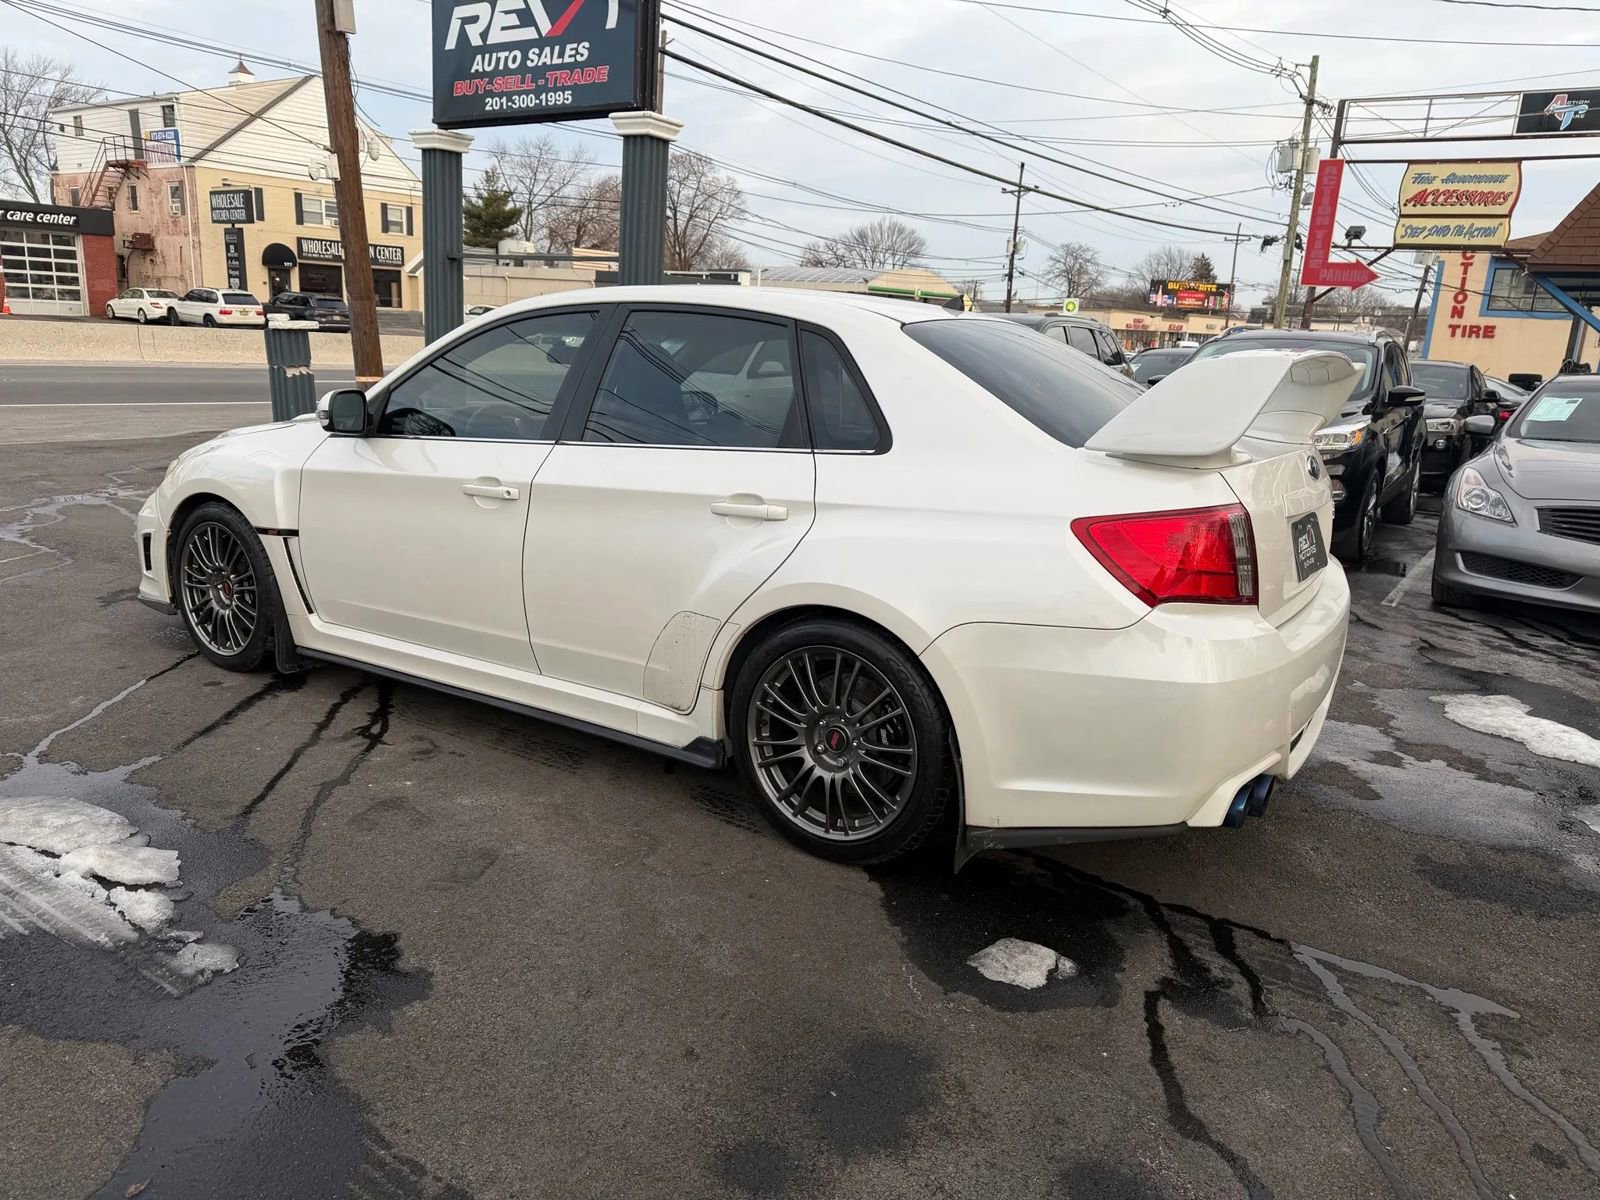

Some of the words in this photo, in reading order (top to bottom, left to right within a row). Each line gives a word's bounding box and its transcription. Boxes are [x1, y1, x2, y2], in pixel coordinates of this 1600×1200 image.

[470, 50, 521, 73] AUTO
[526, 41, 590, 67] SALES
[485, 91, 573, 111] 201-300-1995
[211, 193, 245, 208] WHOLESALE
[1403, 188, 1513, 207] ACCESSORIES
[6, 210, 34, 222] care
[36, 213, 77, 225] center
[212, 209, 230, 220] KITCHEN
[230, 209, 247, 220] CENTER
[301, 239, 342, 256] WHOLESALE
[376, 246, 402, 261] CENTER
[1451, 251, 1476, 319] CTION
[1448, 324, 1497, 339] TIRE
